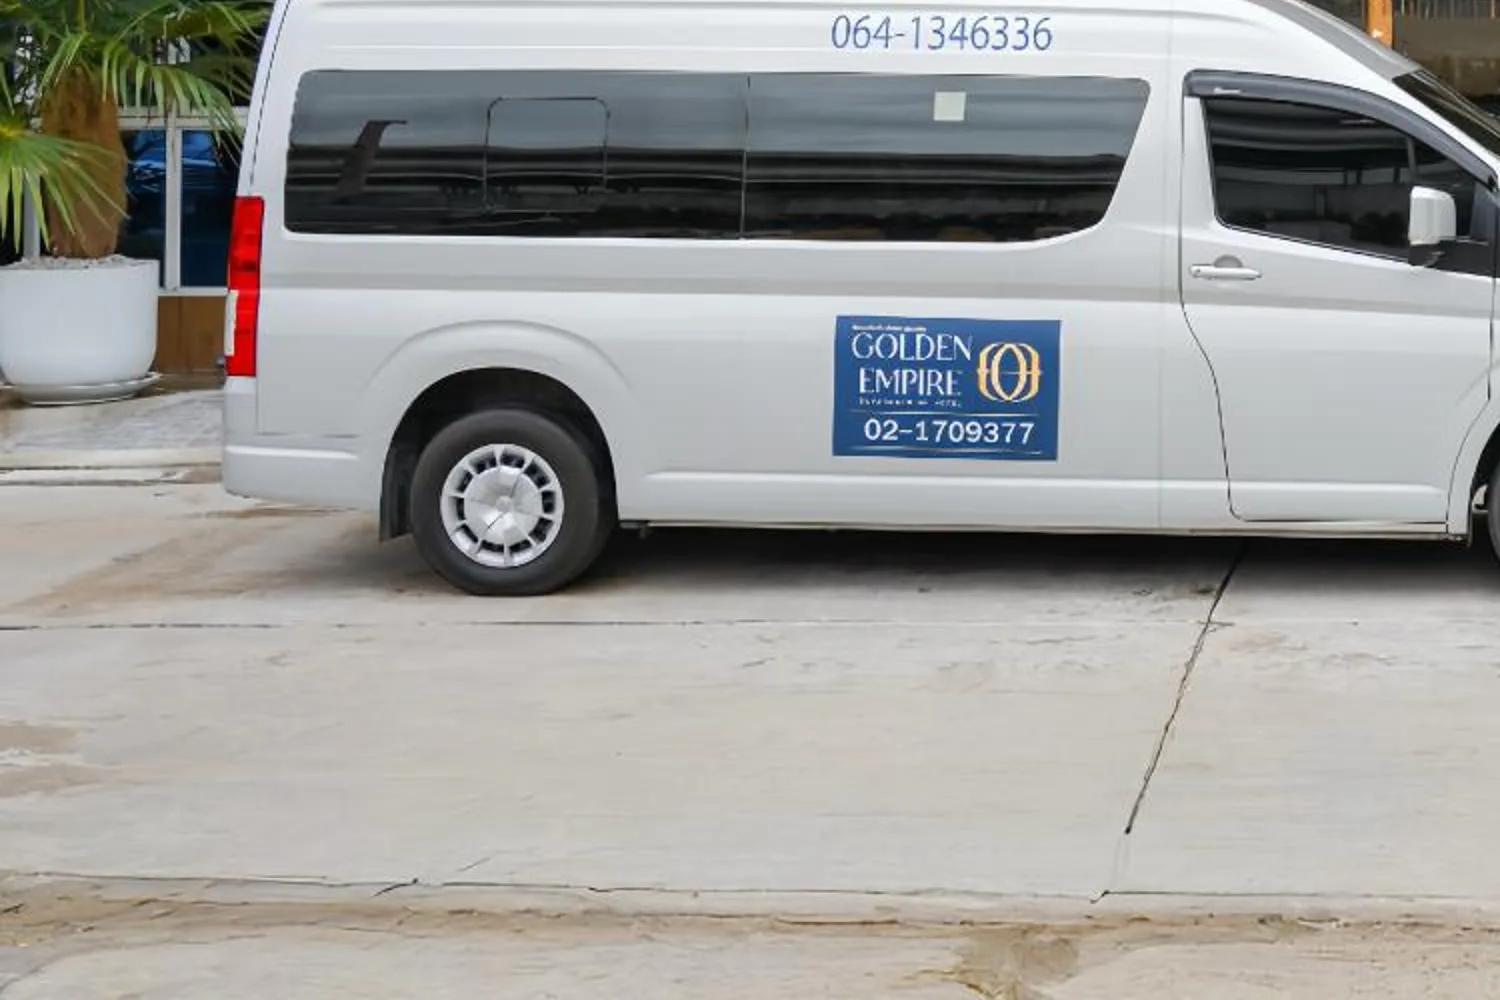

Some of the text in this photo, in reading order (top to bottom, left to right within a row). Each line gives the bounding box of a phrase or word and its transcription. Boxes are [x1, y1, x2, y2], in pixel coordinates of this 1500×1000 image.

[831, 14, 1052, 51] 064-1346336
[851, 331, 973, 361] GOLDEN
[859, 367, 963, 396] EMPIRE
[863, 418, 1035, 445] 02-1709377
